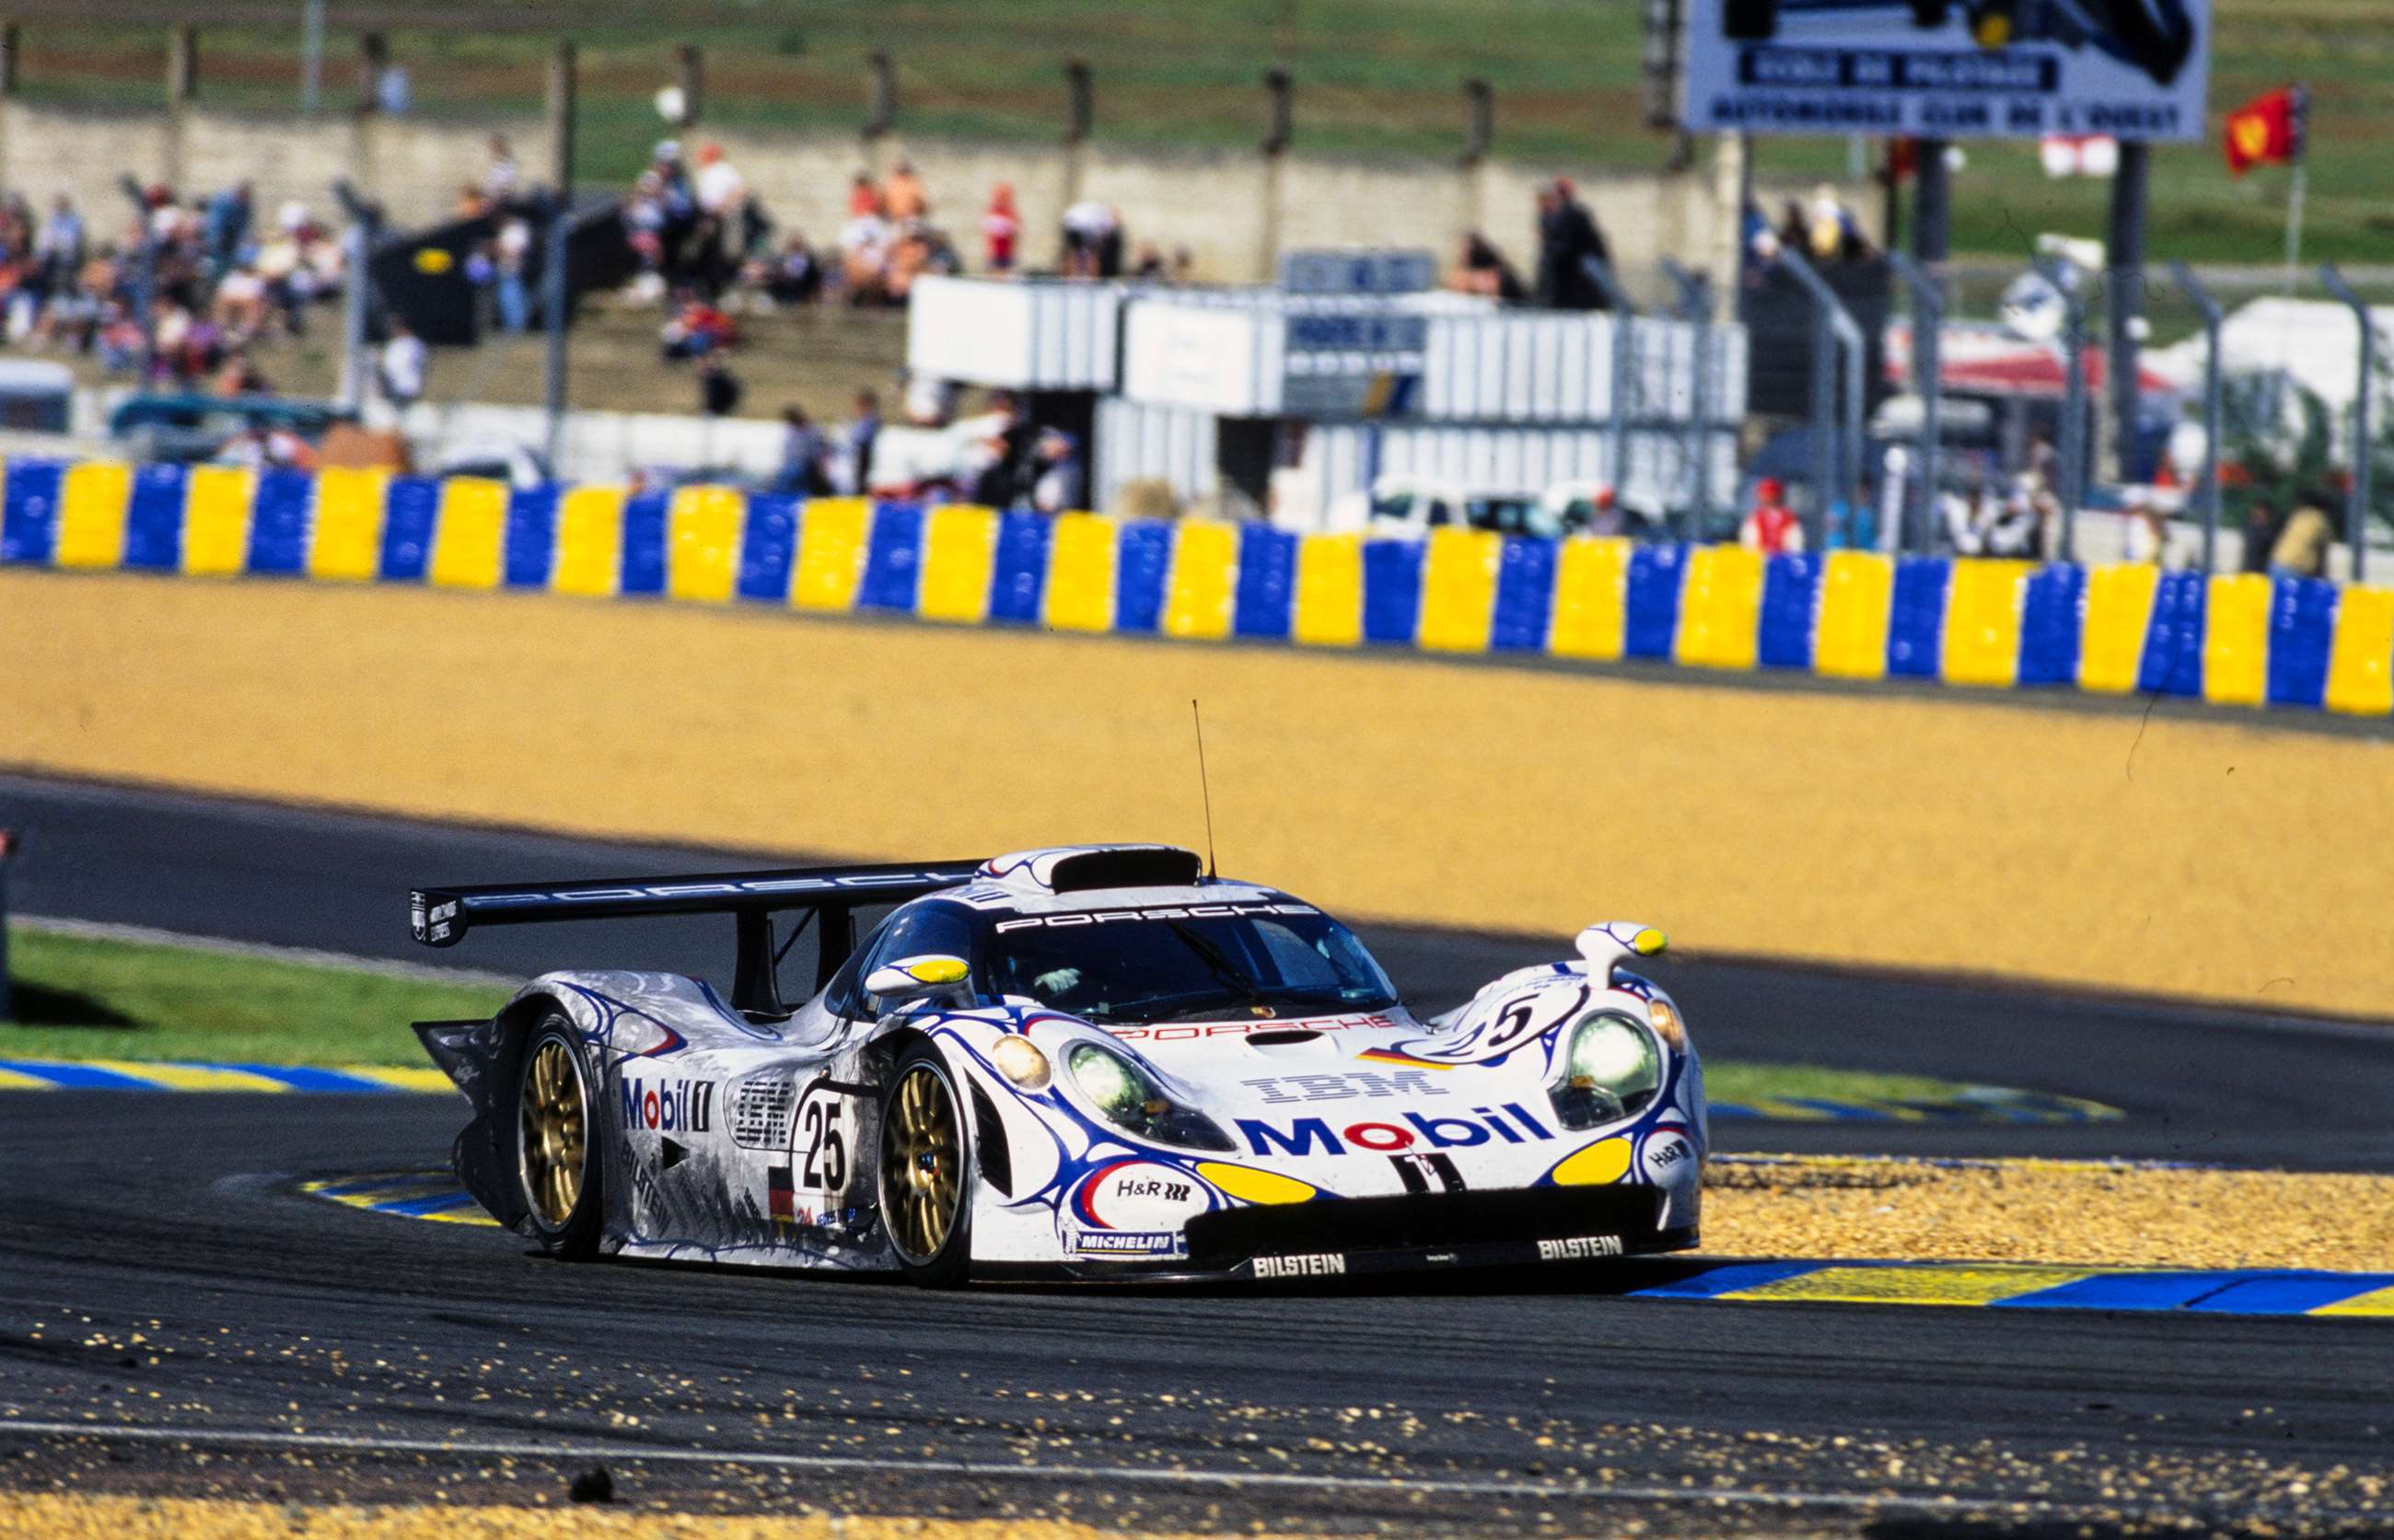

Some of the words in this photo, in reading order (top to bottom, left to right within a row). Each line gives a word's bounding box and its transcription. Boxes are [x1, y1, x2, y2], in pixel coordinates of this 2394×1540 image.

[996, 905, 1319, 933] PORSCHE
[1113, 1015, 1396, 1040] PORSCHE
[1240, 1071, 1451, 1103] IBM
[622, 1078, 690, 1131] Mobil
[1233, 1103, 1556, 1155] Mobil
[804, 1100, 844, 1190] 25
[1117, 1179, 1160, 1197] H&R
[1081, 1235, 1170, 1249] MICHELIN
[1538, 1234, 1623, 1260] BILSTEIN
[1252, 1253, 1346, 1278] BILSTEIN
